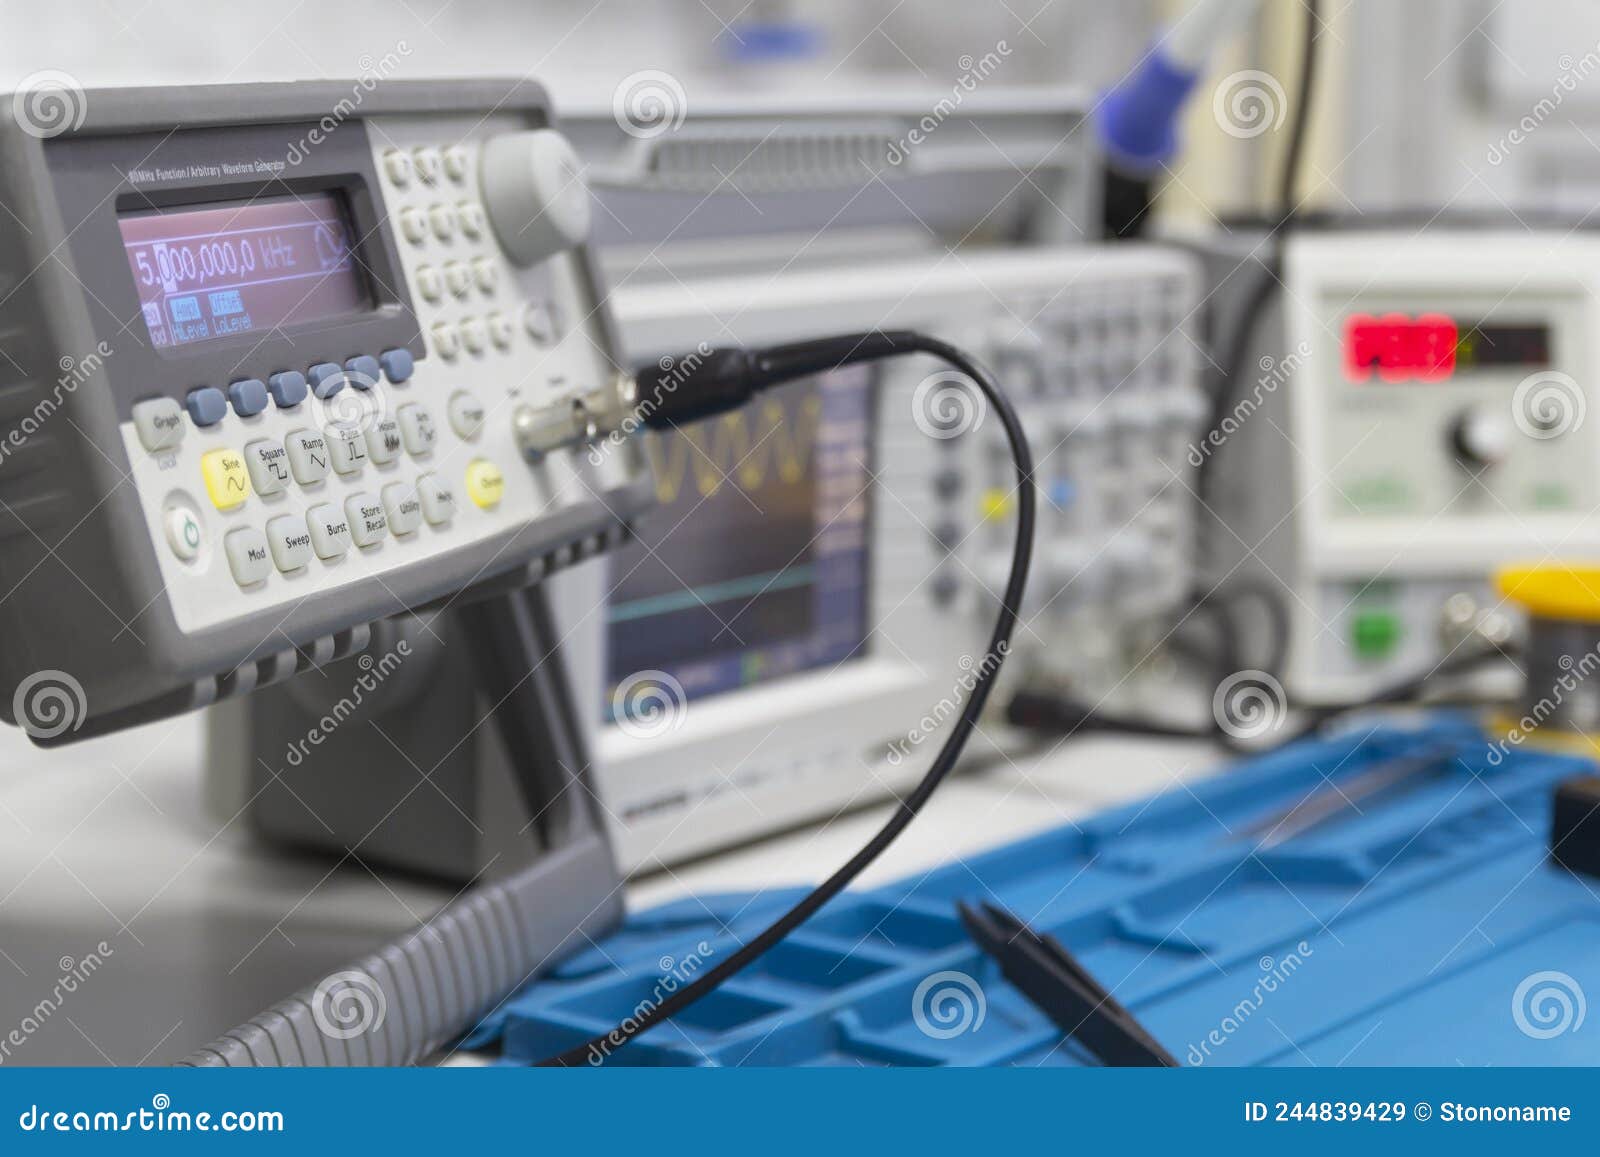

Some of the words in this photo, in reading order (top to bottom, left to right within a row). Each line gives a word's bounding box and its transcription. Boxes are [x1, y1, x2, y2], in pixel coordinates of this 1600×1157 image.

[221, 162, 254, 176] Waveform
[258, 236, 296, 269] kHz
[153, 414, 180, 430] Graph
[301, 437, 324, 453] Ramp
[258, 447, 286, 462] Square
[222, 458, 241, 471] Sine
[360, 505, 381, 519] Store
[326, 522, 347, 536] Burst
[366, 518, 387, 532] Recall
[286, 533, 310, 549] Sweep
[247, 547, 266, 562] Mod
